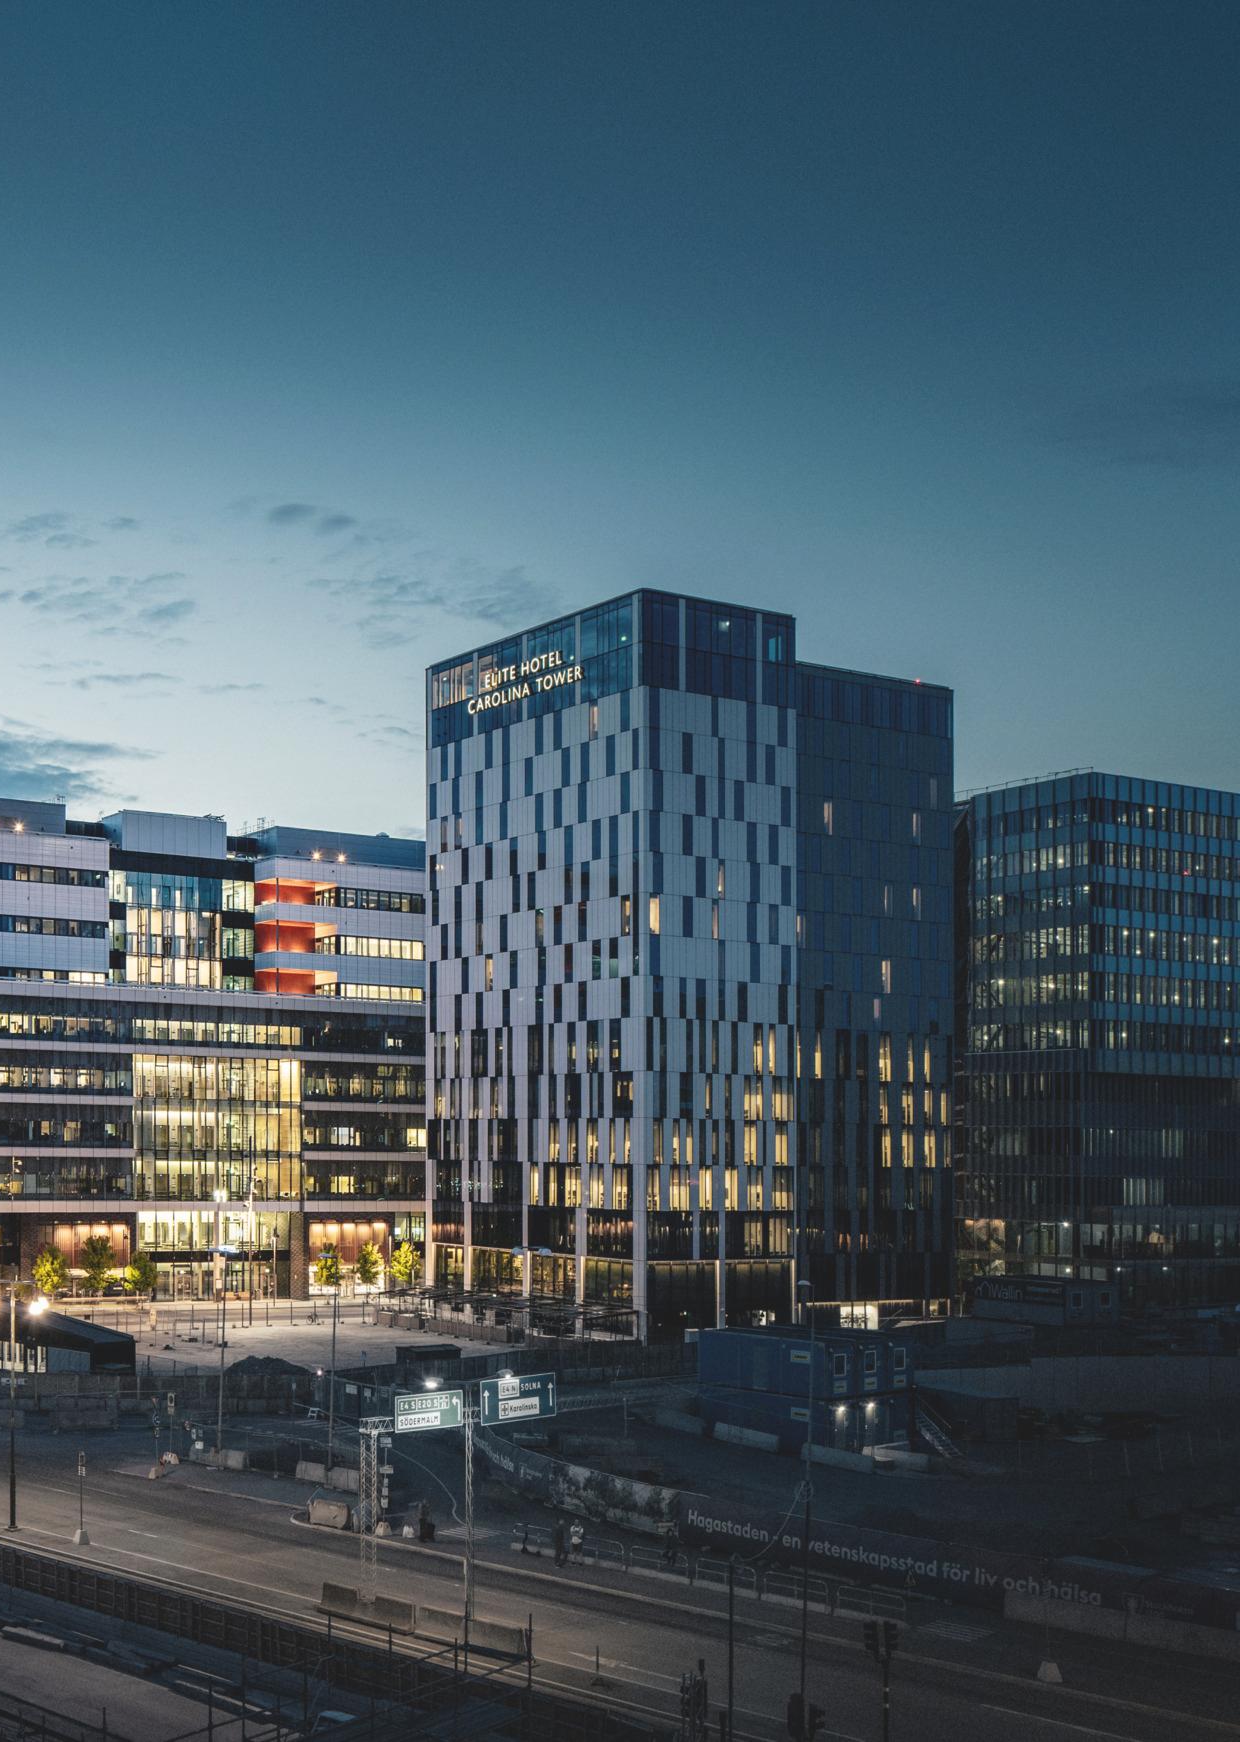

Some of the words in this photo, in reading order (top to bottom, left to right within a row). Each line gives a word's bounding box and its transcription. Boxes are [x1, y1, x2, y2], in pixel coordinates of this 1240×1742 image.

[484, 665, 516, 688] ELITE
[521, 651, 562, 677] HOTEL
[467, 682, 530, 715] CAROLINA
[536, 665, 583, 692] TOWER
[501, 1386, 510, 1394] E4
[520, 1381, 541, 1391] SOLNA
[400, 1401, 409, 1410] E4
[418, 1398, 432, 1409] E20
[510, 1402, 538, 1413] Karolinska
[399, 1415, 439, 1427] SÖDERMALM
[688, 1509, 769, 1542] Hagastaden
[782, 1535, 801, 1549] en
[942, 1561, 971, 1583] för
[974, 1567, 999, 1587] liv
[1003, 1576, 1039, 1596] och
[1047, 1579, 1102, 1606] hälsa
